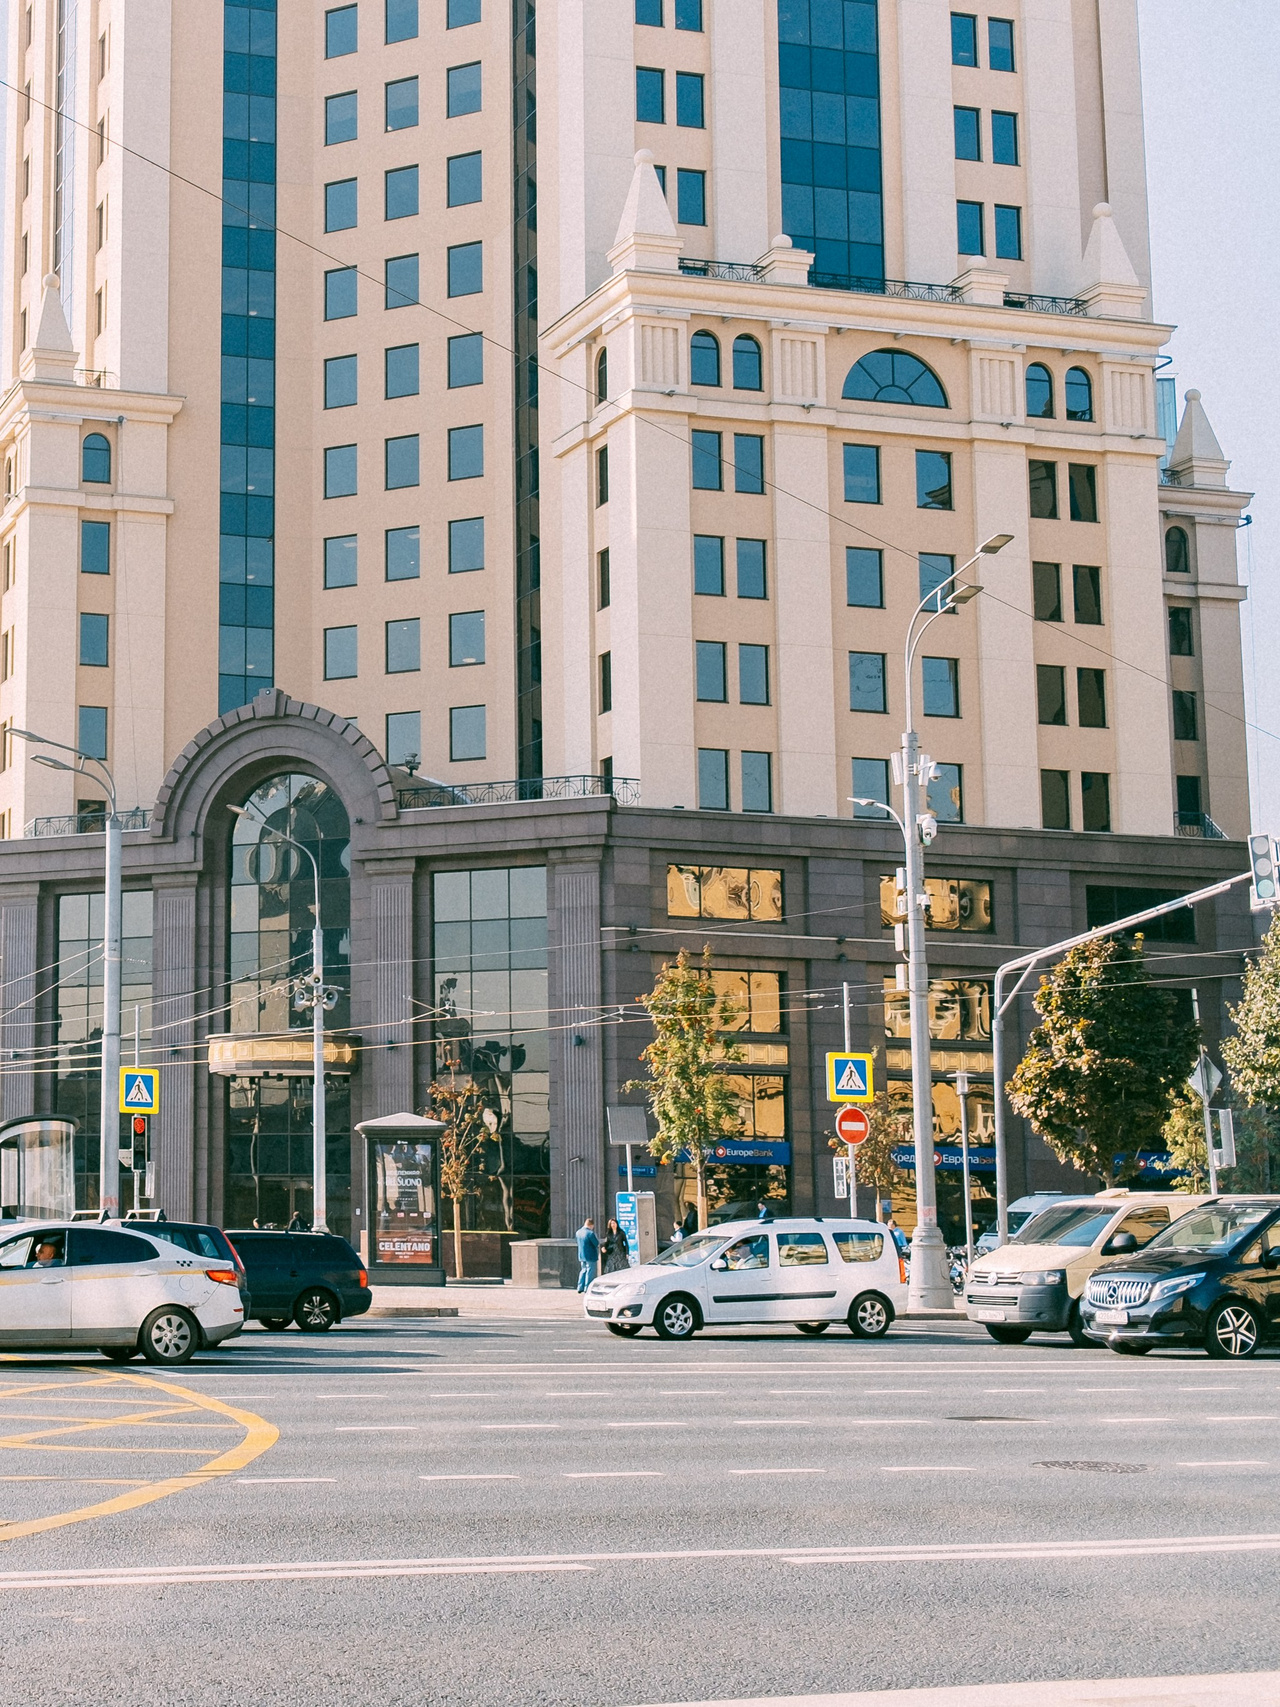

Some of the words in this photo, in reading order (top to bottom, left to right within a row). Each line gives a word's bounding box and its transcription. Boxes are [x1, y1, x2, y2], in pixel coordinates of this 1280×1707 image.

[726, 1148, 774, 1158] EuropeBank
[890, 1152, 915, 1164] Кред
[378, 1241, 431, 1252] CELENTANO
